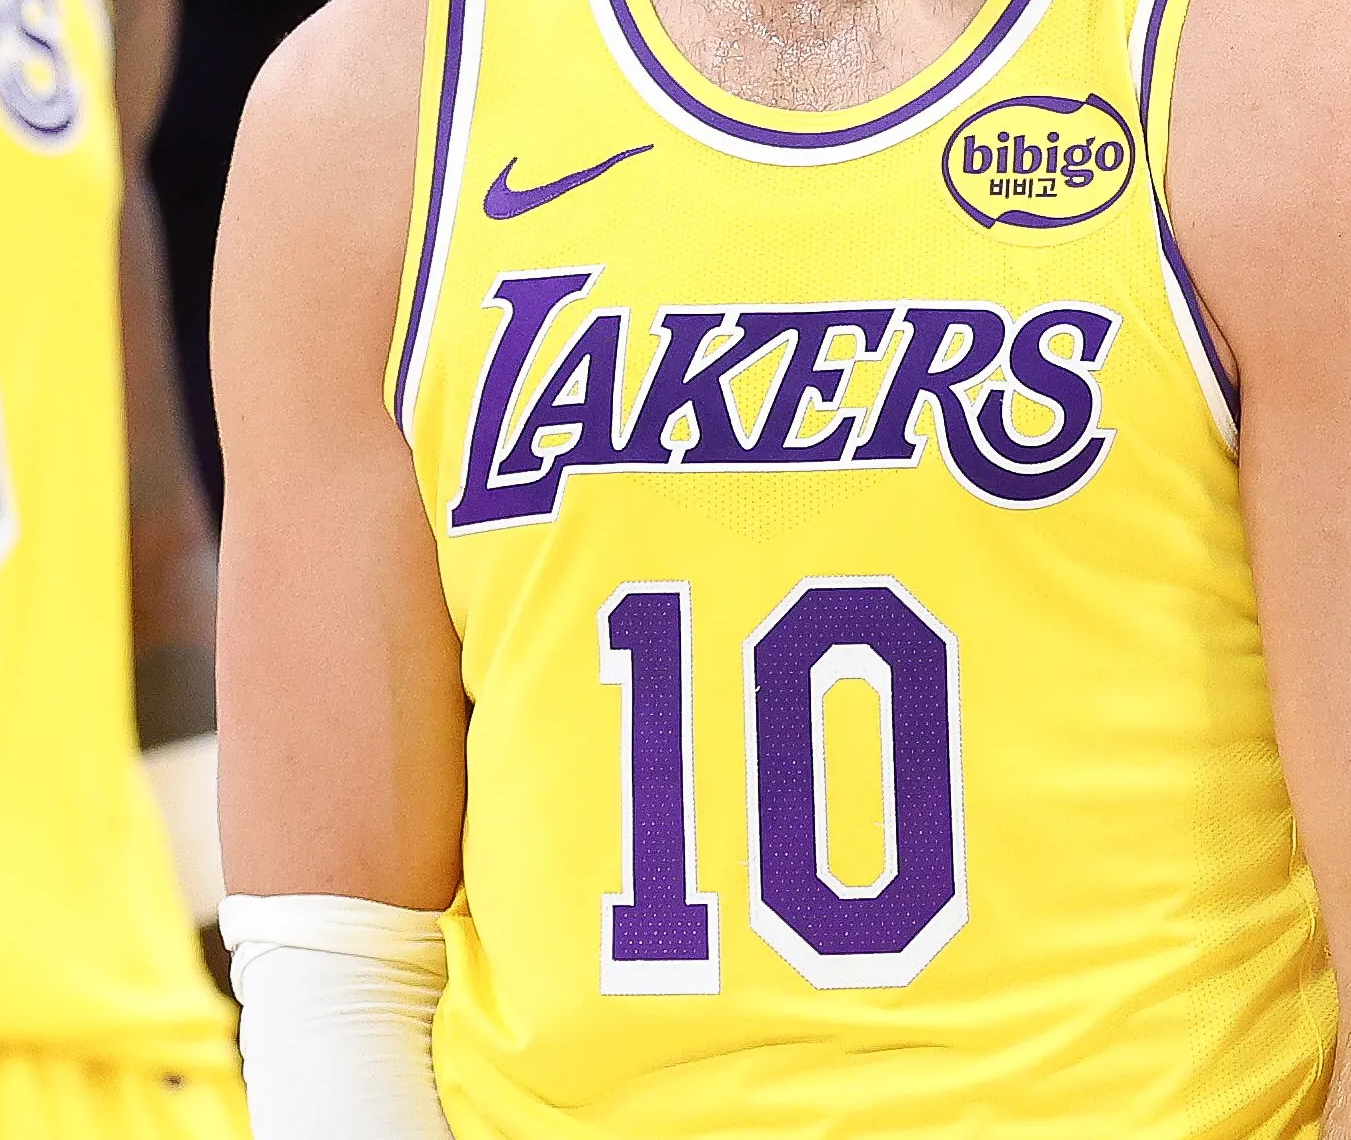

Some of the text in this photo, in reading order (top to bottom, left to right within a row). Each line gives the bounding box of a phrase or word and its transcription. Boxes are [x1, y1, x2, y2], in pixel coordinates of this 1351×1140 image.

[963, 131, 1124, 187] bibigo
[989, 177, 1057, 198] 비비고
[449, 267, 1122, 535] LAKERS
[600, 577, 969, 992] 10
